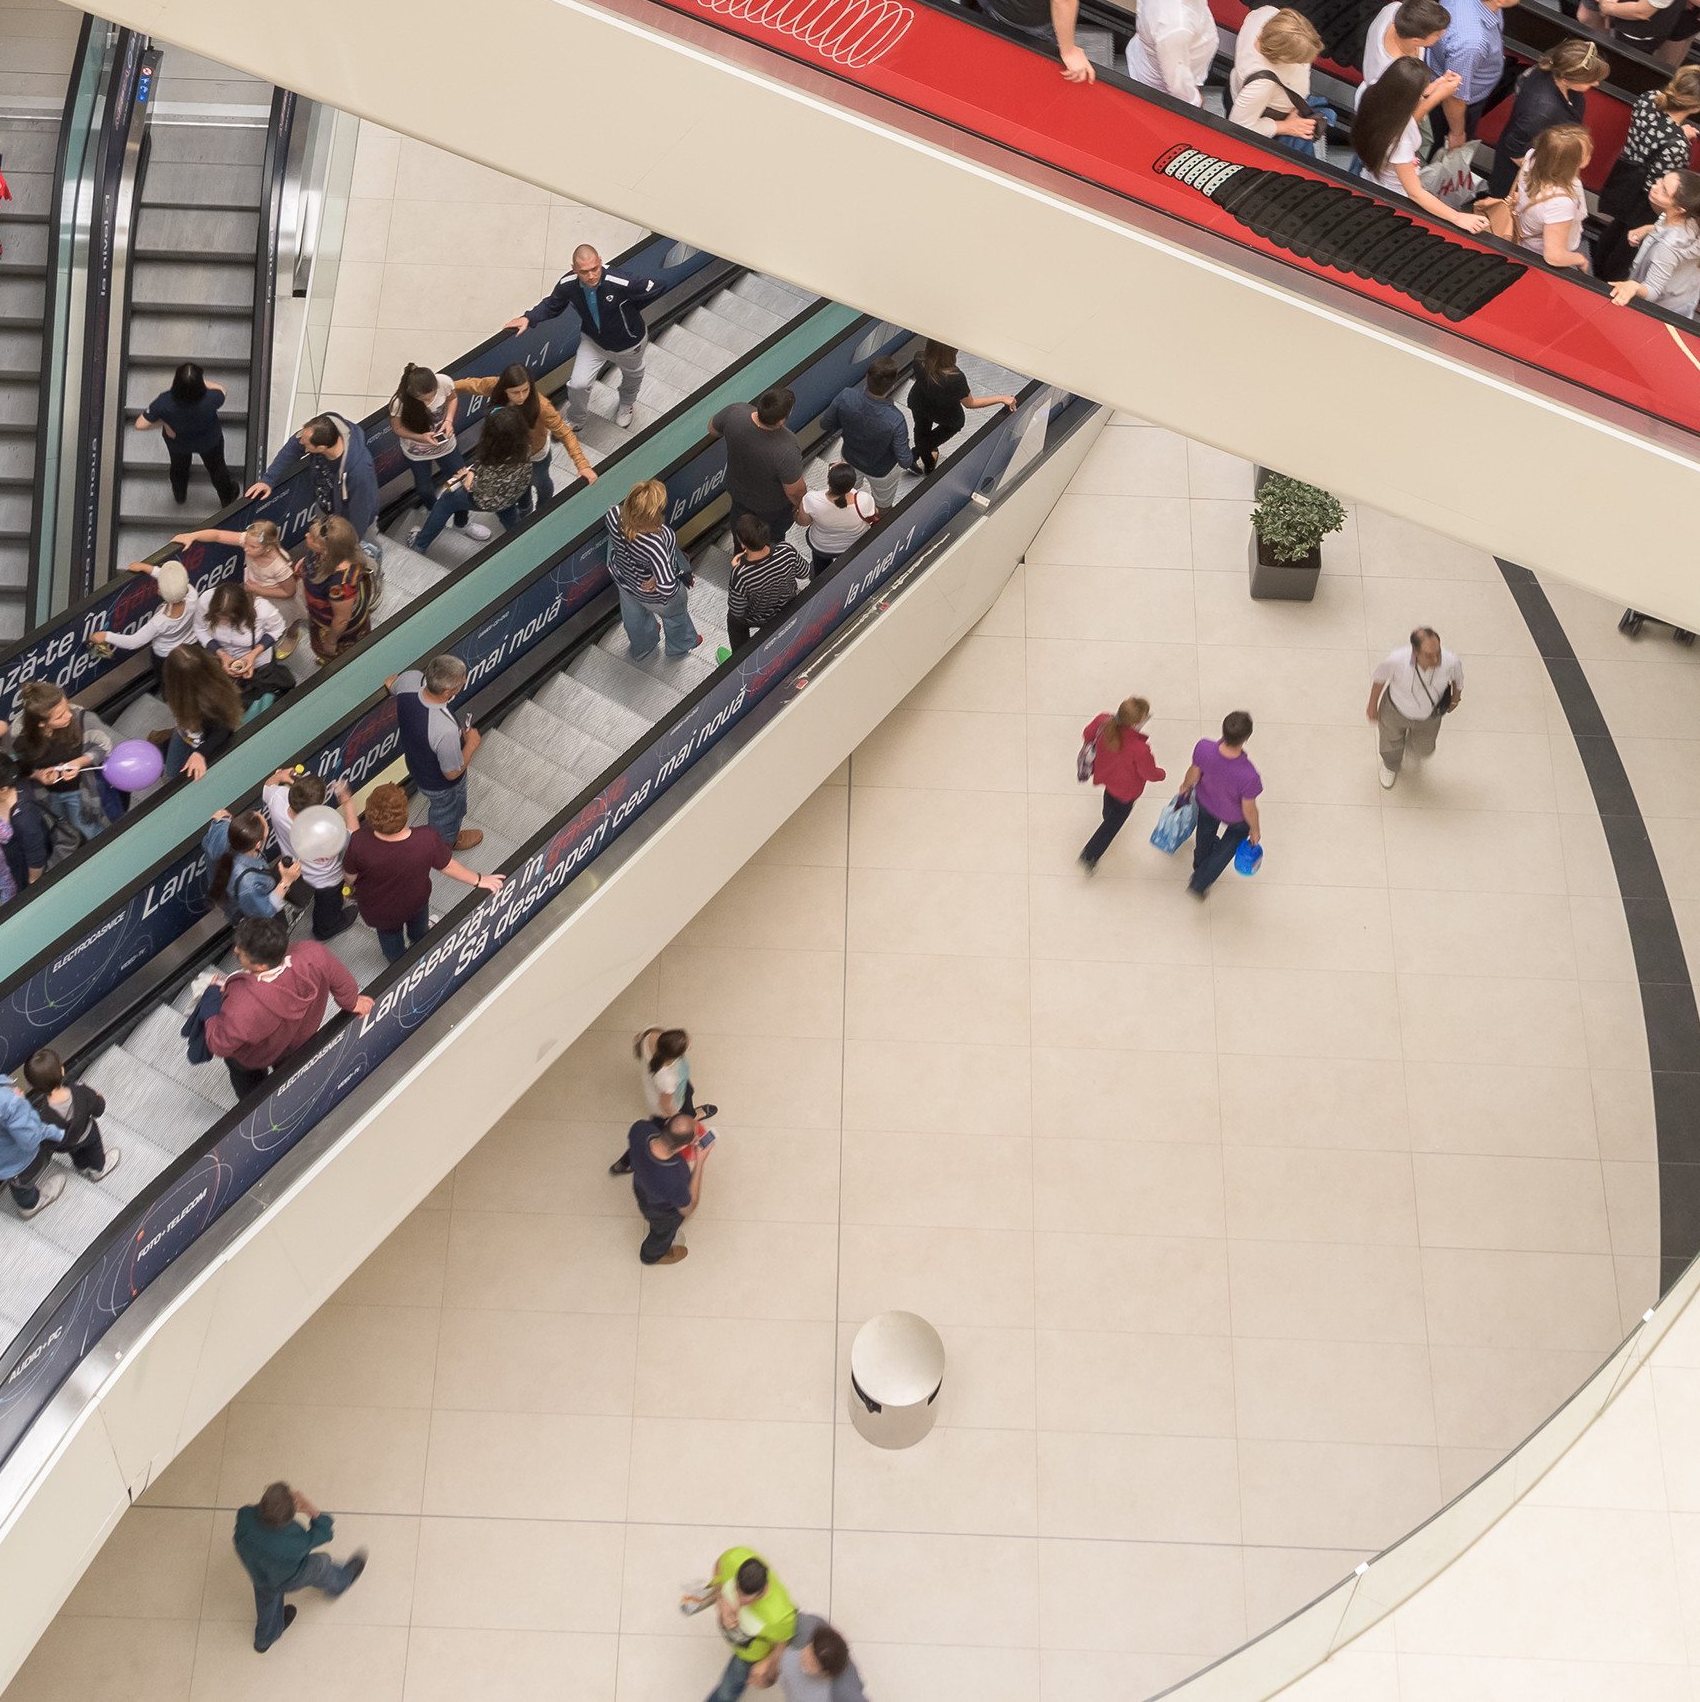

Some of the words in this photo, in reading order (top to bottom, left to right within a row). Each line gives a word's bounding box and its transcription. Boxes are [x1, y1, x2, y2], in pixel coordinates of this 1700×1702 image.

[669, 498, 689, 525] la
[687, 464, 729, 512] nivel
[196, 554, 238, 597] cea
[83, 607, 108, 642] în
[463, 642, 506, 693] mai
[507, 593, 564, 660] nouă
[454, 926, 490, 978] Să
[494, 810, 613, 940] descoperi
[612, 778, 653, 828] cea
[654, 730, 699, 788] mai
[696, 682, 749, 749] nouă
[843, 583, 861, 609] la
[861, 539, 901, 586] nivel
[898, 524, 917, 553] -1
[52, 910, 127, 974] ELECTROCASNICE
[359, 878, 517, 1038] Lansează-te
[520, 852, 545, 890] în
[277, 1029, 346, 1097] ELECTROCASNICE
[137, 1188, 208, 1262] FOTO+TELECOM
